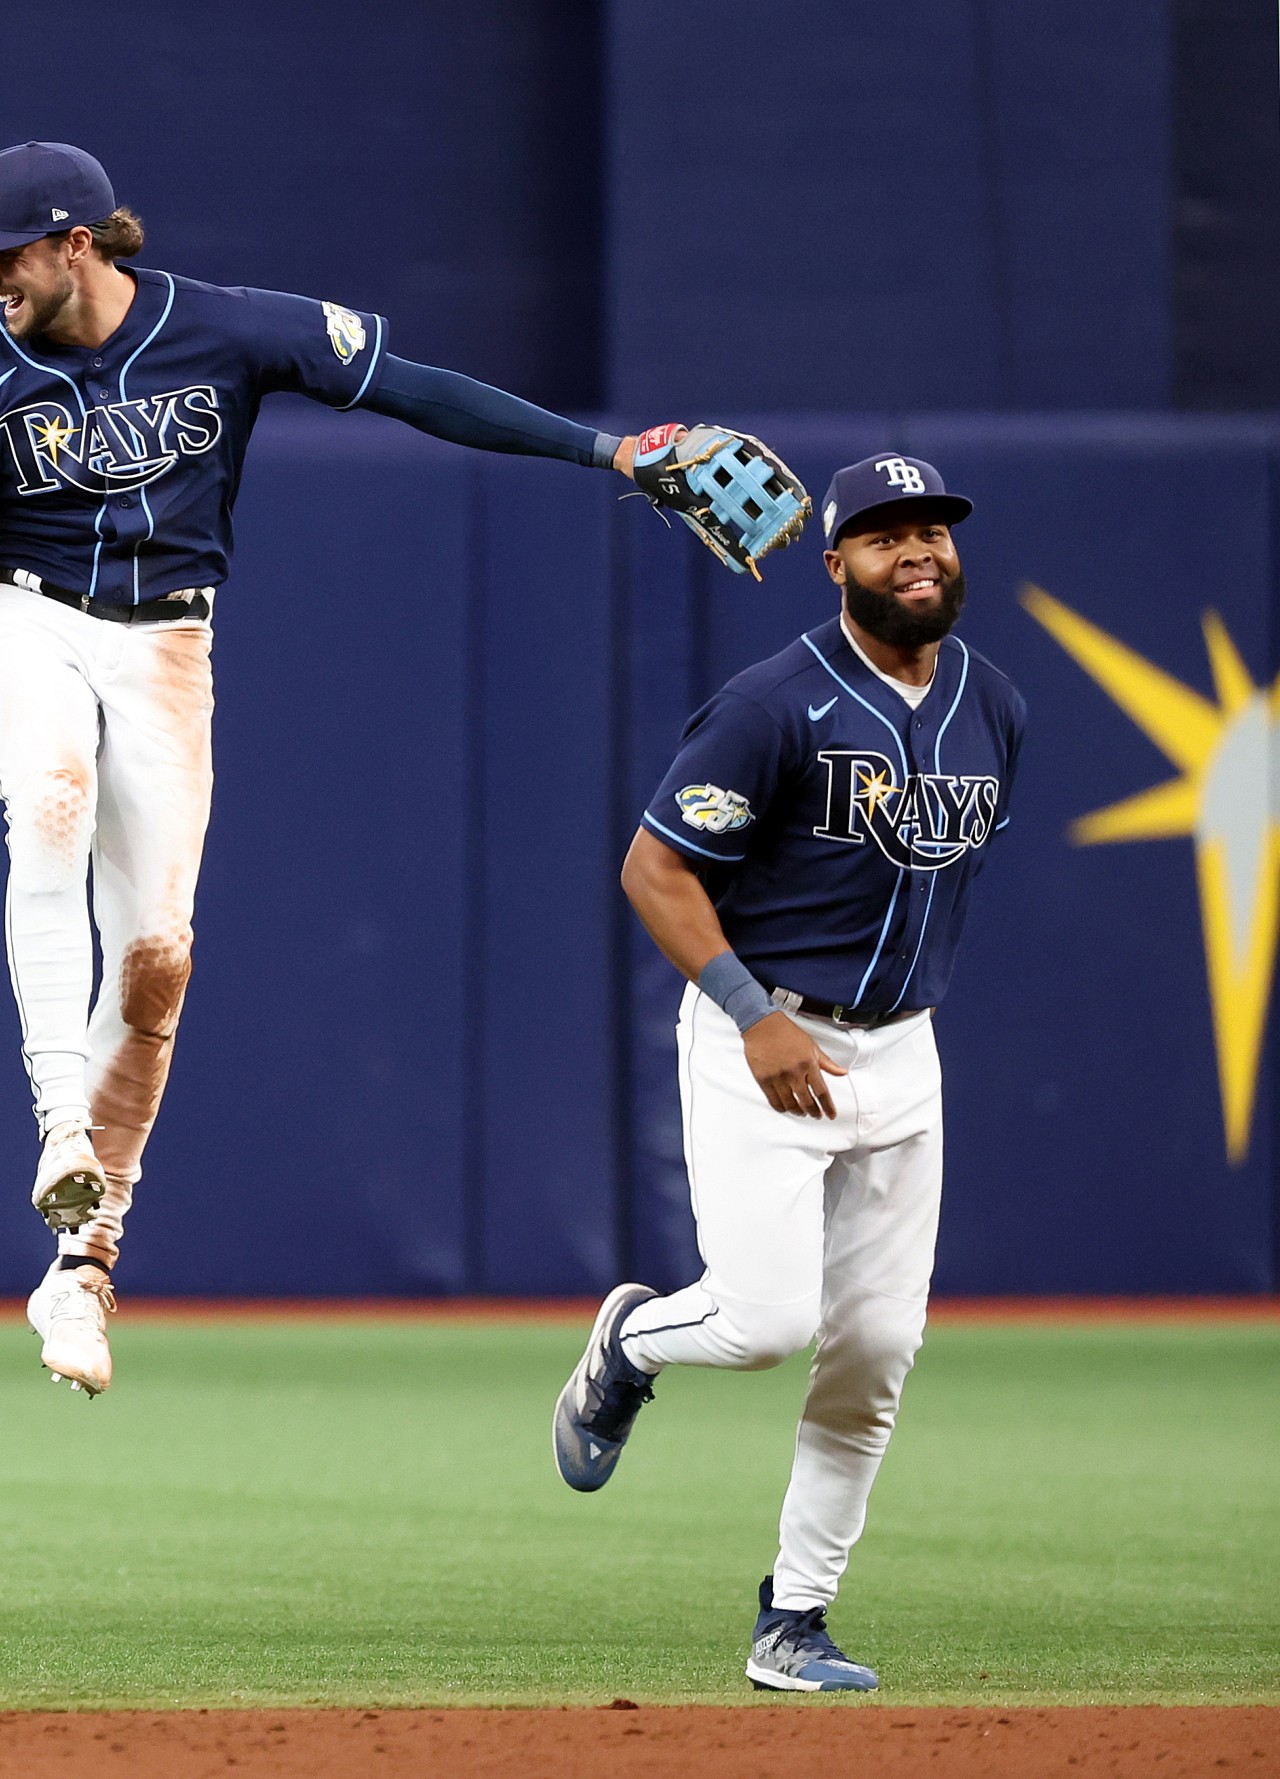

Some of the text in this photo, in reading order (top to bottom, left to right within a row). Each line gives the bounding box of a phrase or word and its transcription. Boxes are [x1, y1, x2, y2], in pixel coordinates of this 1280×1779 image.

[658, 476, 680, 495] 15
[875, 457, 926, 494] TB
[681, 783, 750, 835] 25
[813, 750, 1000, 872] RAYS
